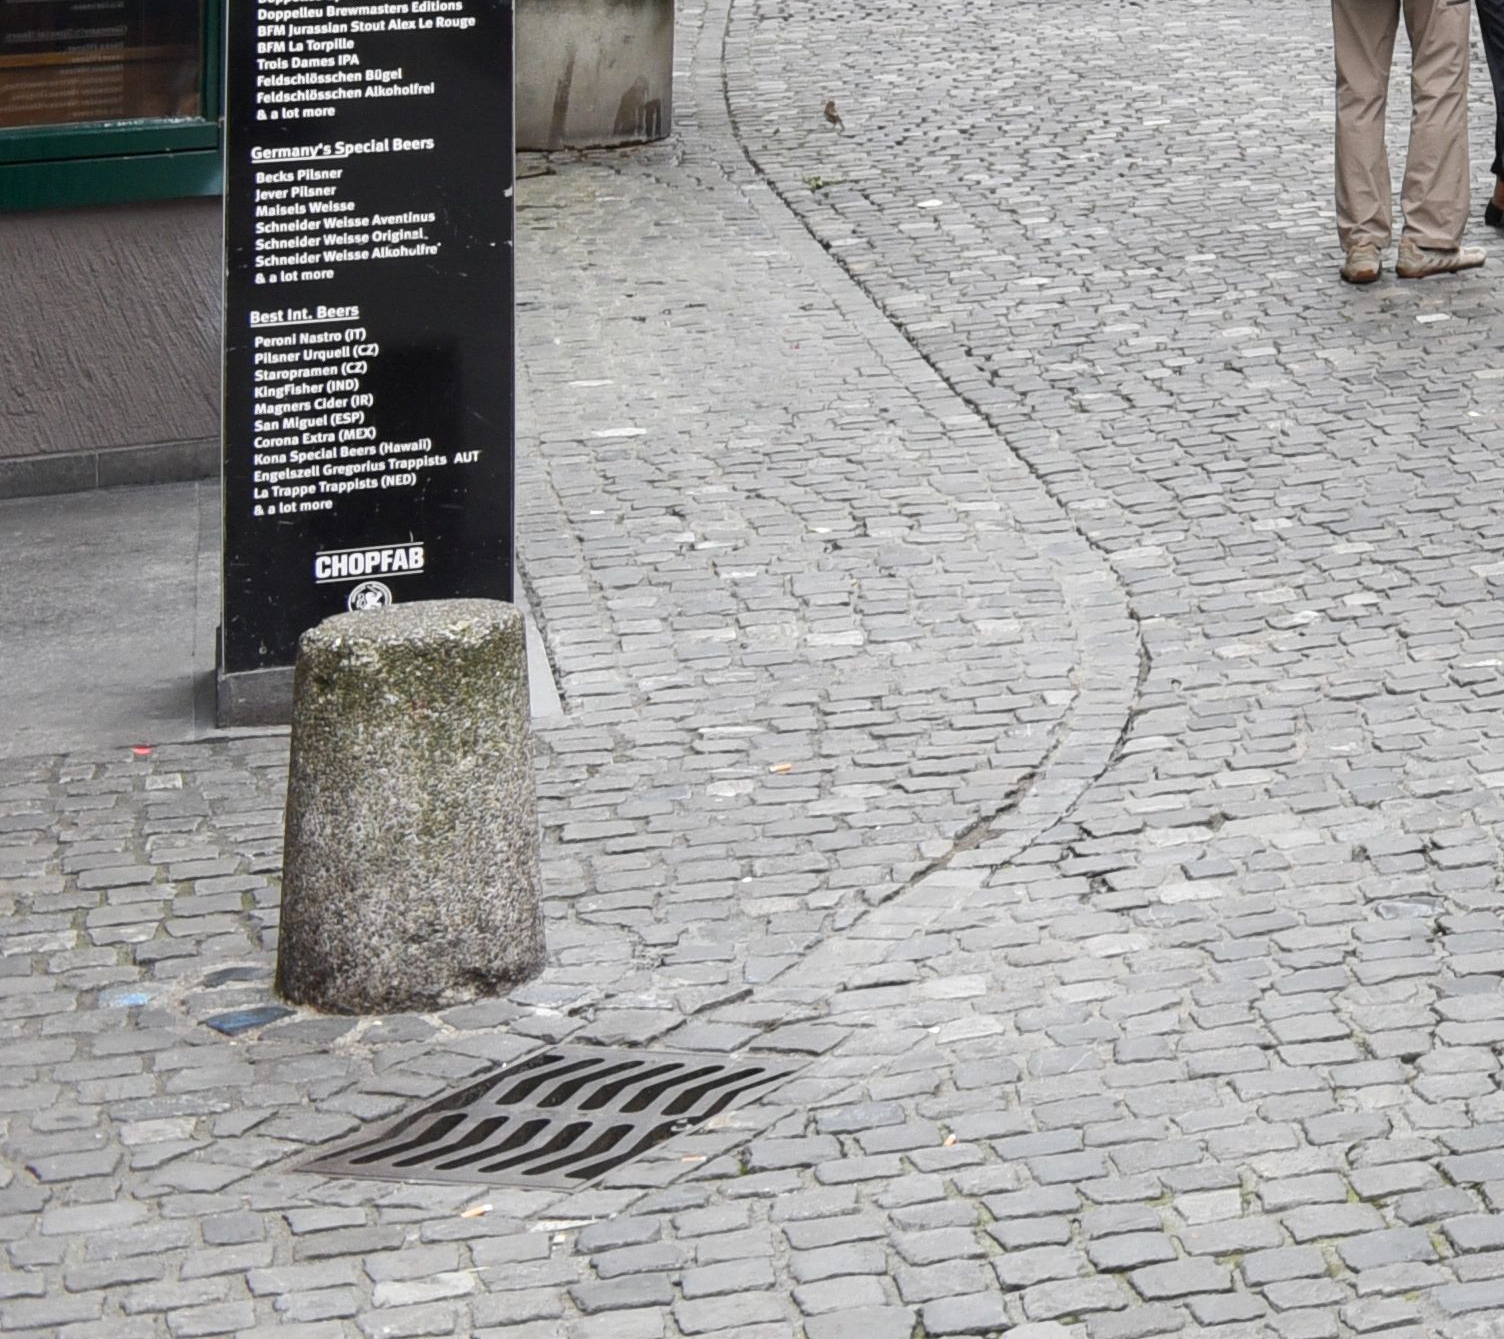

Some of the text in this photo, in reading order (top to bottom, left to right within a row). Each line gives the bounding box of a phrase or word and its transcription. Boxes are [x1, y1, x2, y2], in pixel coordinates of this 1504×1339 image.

[257, 37, 355, 54] BFM La Torpille
[256, 53, 360, 70] Trois Dames IPA
[257, 67, 403, 87] Feldschlösschen Bügel
[256, 82, 435, 104] Feldschlösschen Alkoholfrei
[251, 137, 435, 160] Germany's Special Beers
[255, 168, 343, 184] Becks Pilsner
[255, 200, 355, 217] Maisels Weisse
[250, 305, 360, 325] Best Int. Beers
[254, 327, 367, 348] Peroni Nastro (IT)
[254, 342, 379, 365] Pilsner Urquell (CZ)
[254, 360, 368, 382] Staropramen (CZ)
[254, 410, 365, 432] San Miguel (ESP)
[253, 426, 377, 449] Corona Extra (MEX)
[314, 547, 424, 581] CHOPFAB
